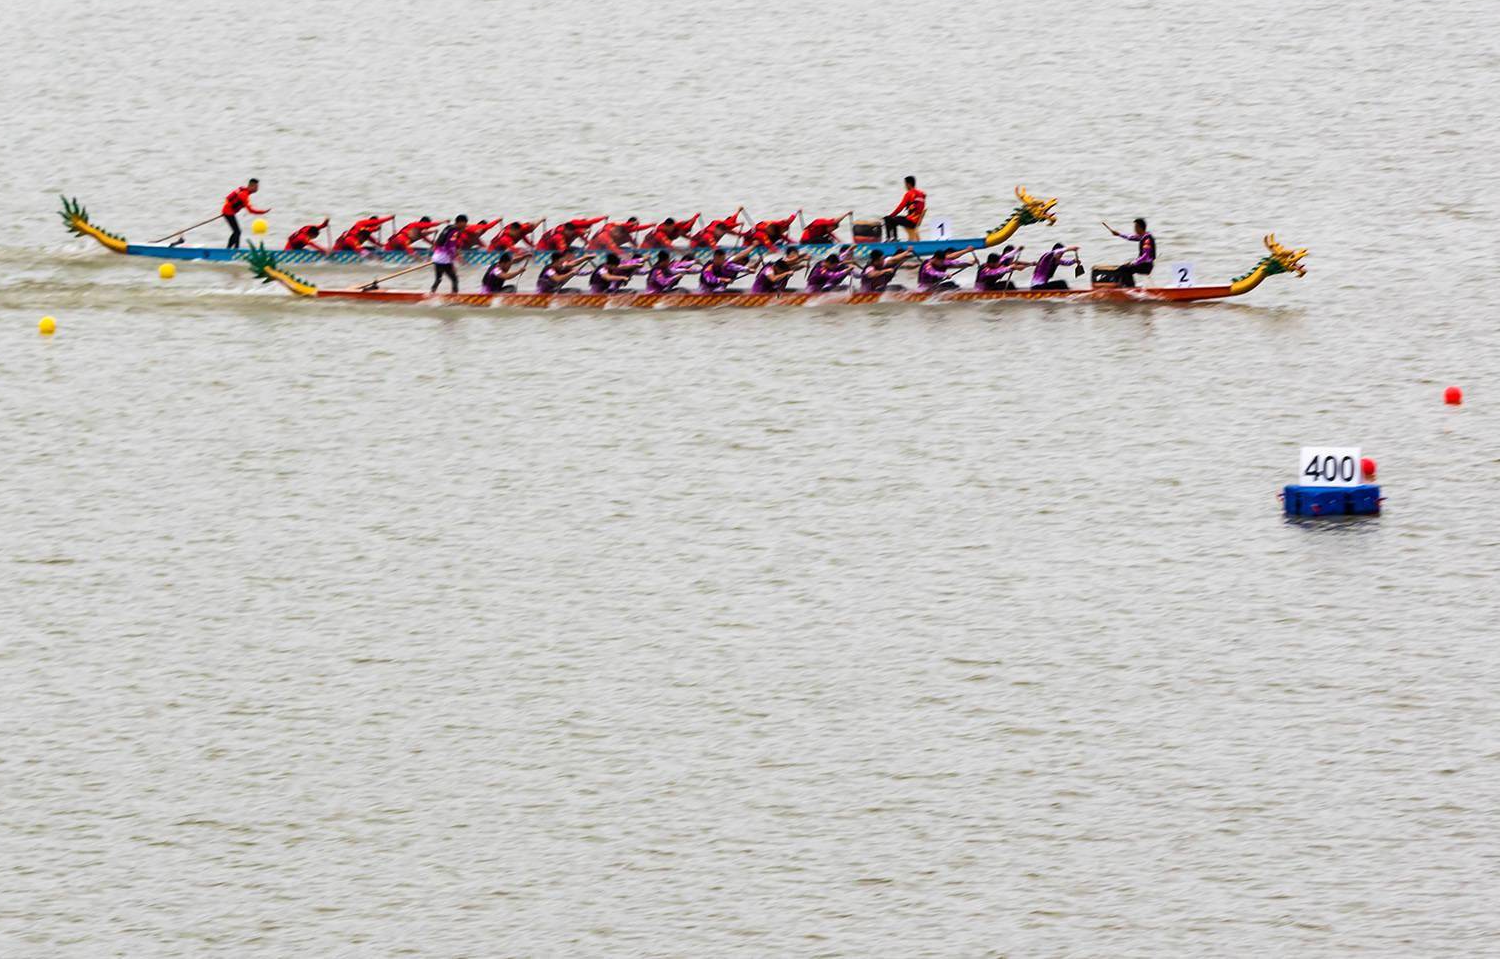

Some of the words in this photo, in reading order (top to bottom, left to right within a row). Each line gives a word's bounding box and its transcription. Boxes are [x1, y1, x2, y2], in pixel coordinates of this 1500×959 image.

[936, 222, 945, 237] 1
[1177, 267, 1190, 283] 2
[1303, 454, 1355, 483] 400
